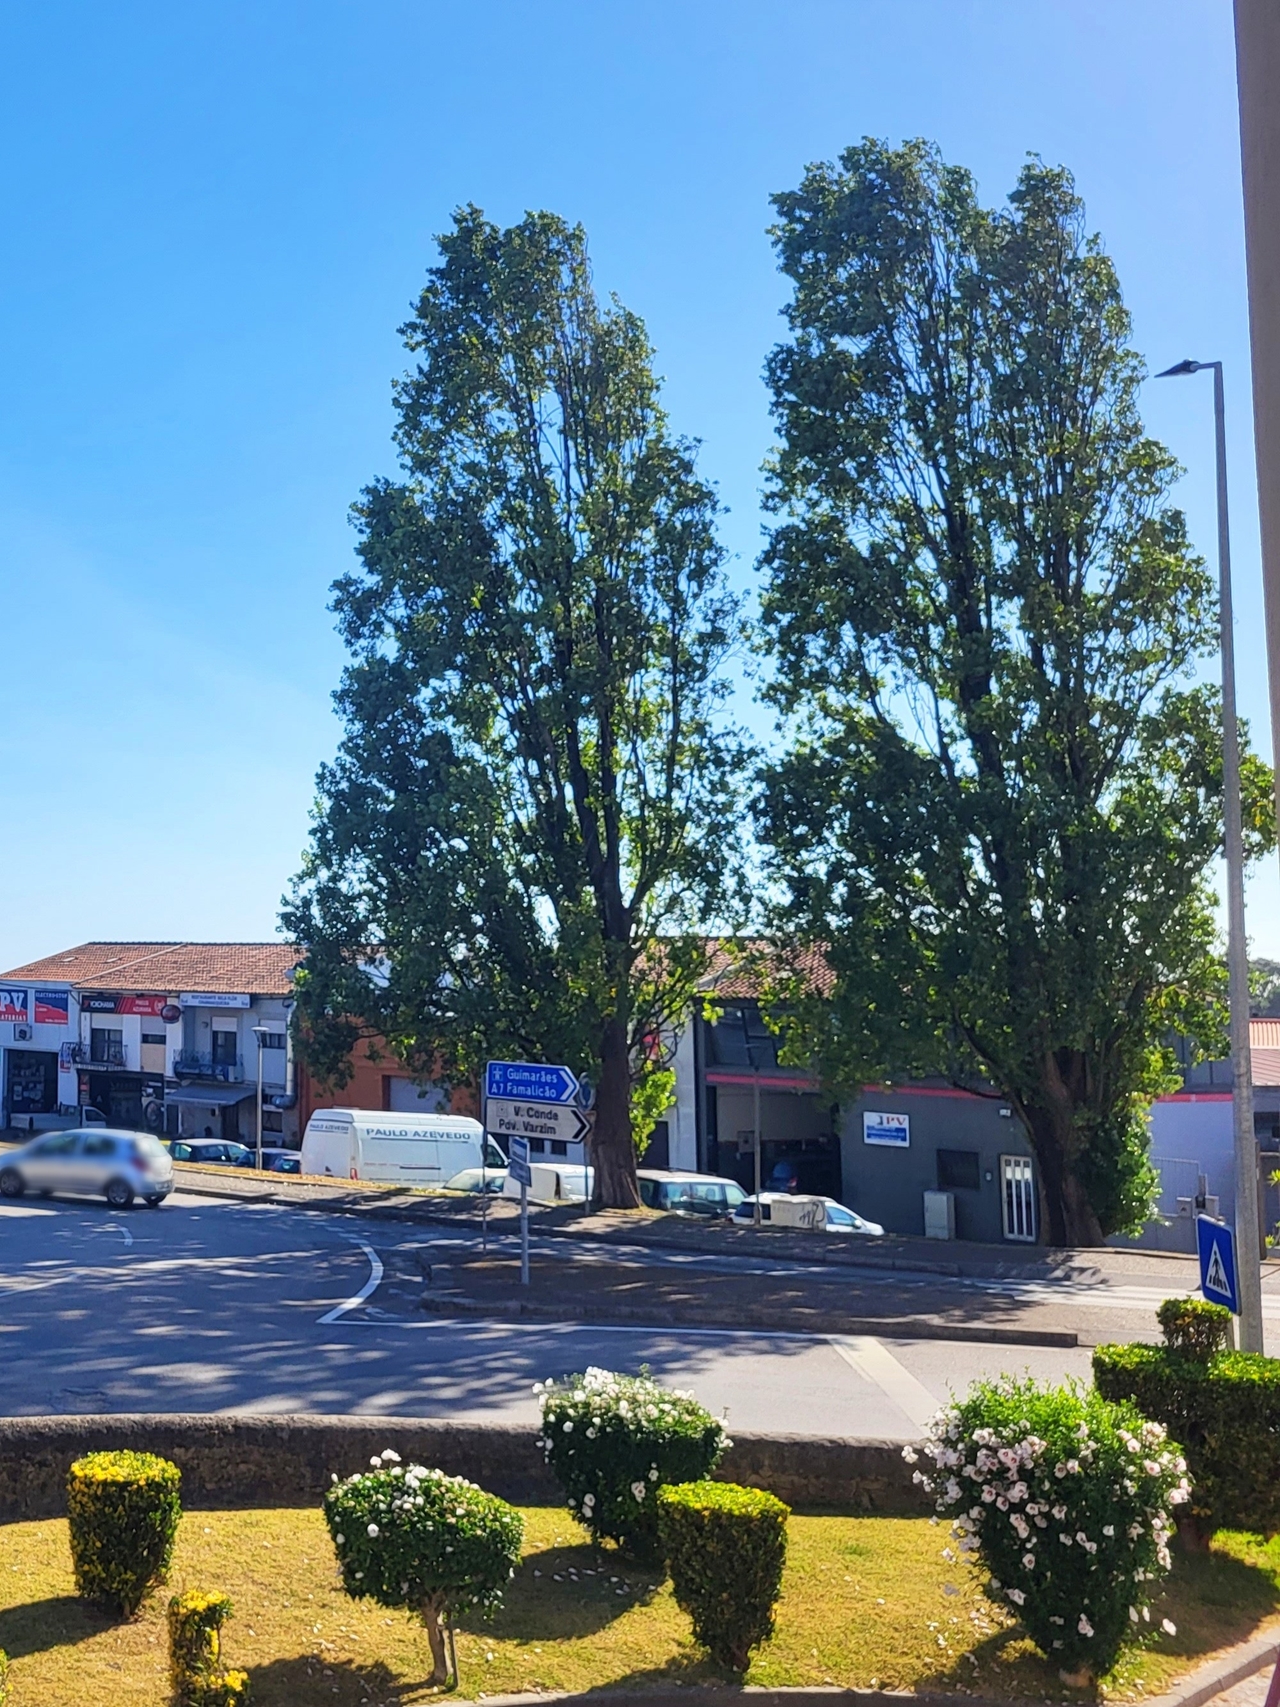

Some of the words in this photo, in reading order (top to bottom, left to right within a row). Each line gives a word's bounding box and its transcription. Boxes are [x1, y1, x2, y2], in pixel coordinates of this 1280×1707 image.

[0, 991, 25, 1012] PV
[507, 1068, 558, 1083] Guimarães
[506, 1082, 557, 1098] Famalicão
[513, 1105, 524, 1117] V.
[526, 1107, 559, 1121] Conde
[325, 1124, 349, 1132] AZEVEDO
[366, 1128, 408, 1137] PAULO
[412, 1130, 471, 1140] AZEVEDO
[522, 1120, 557, 1135] Varzim
